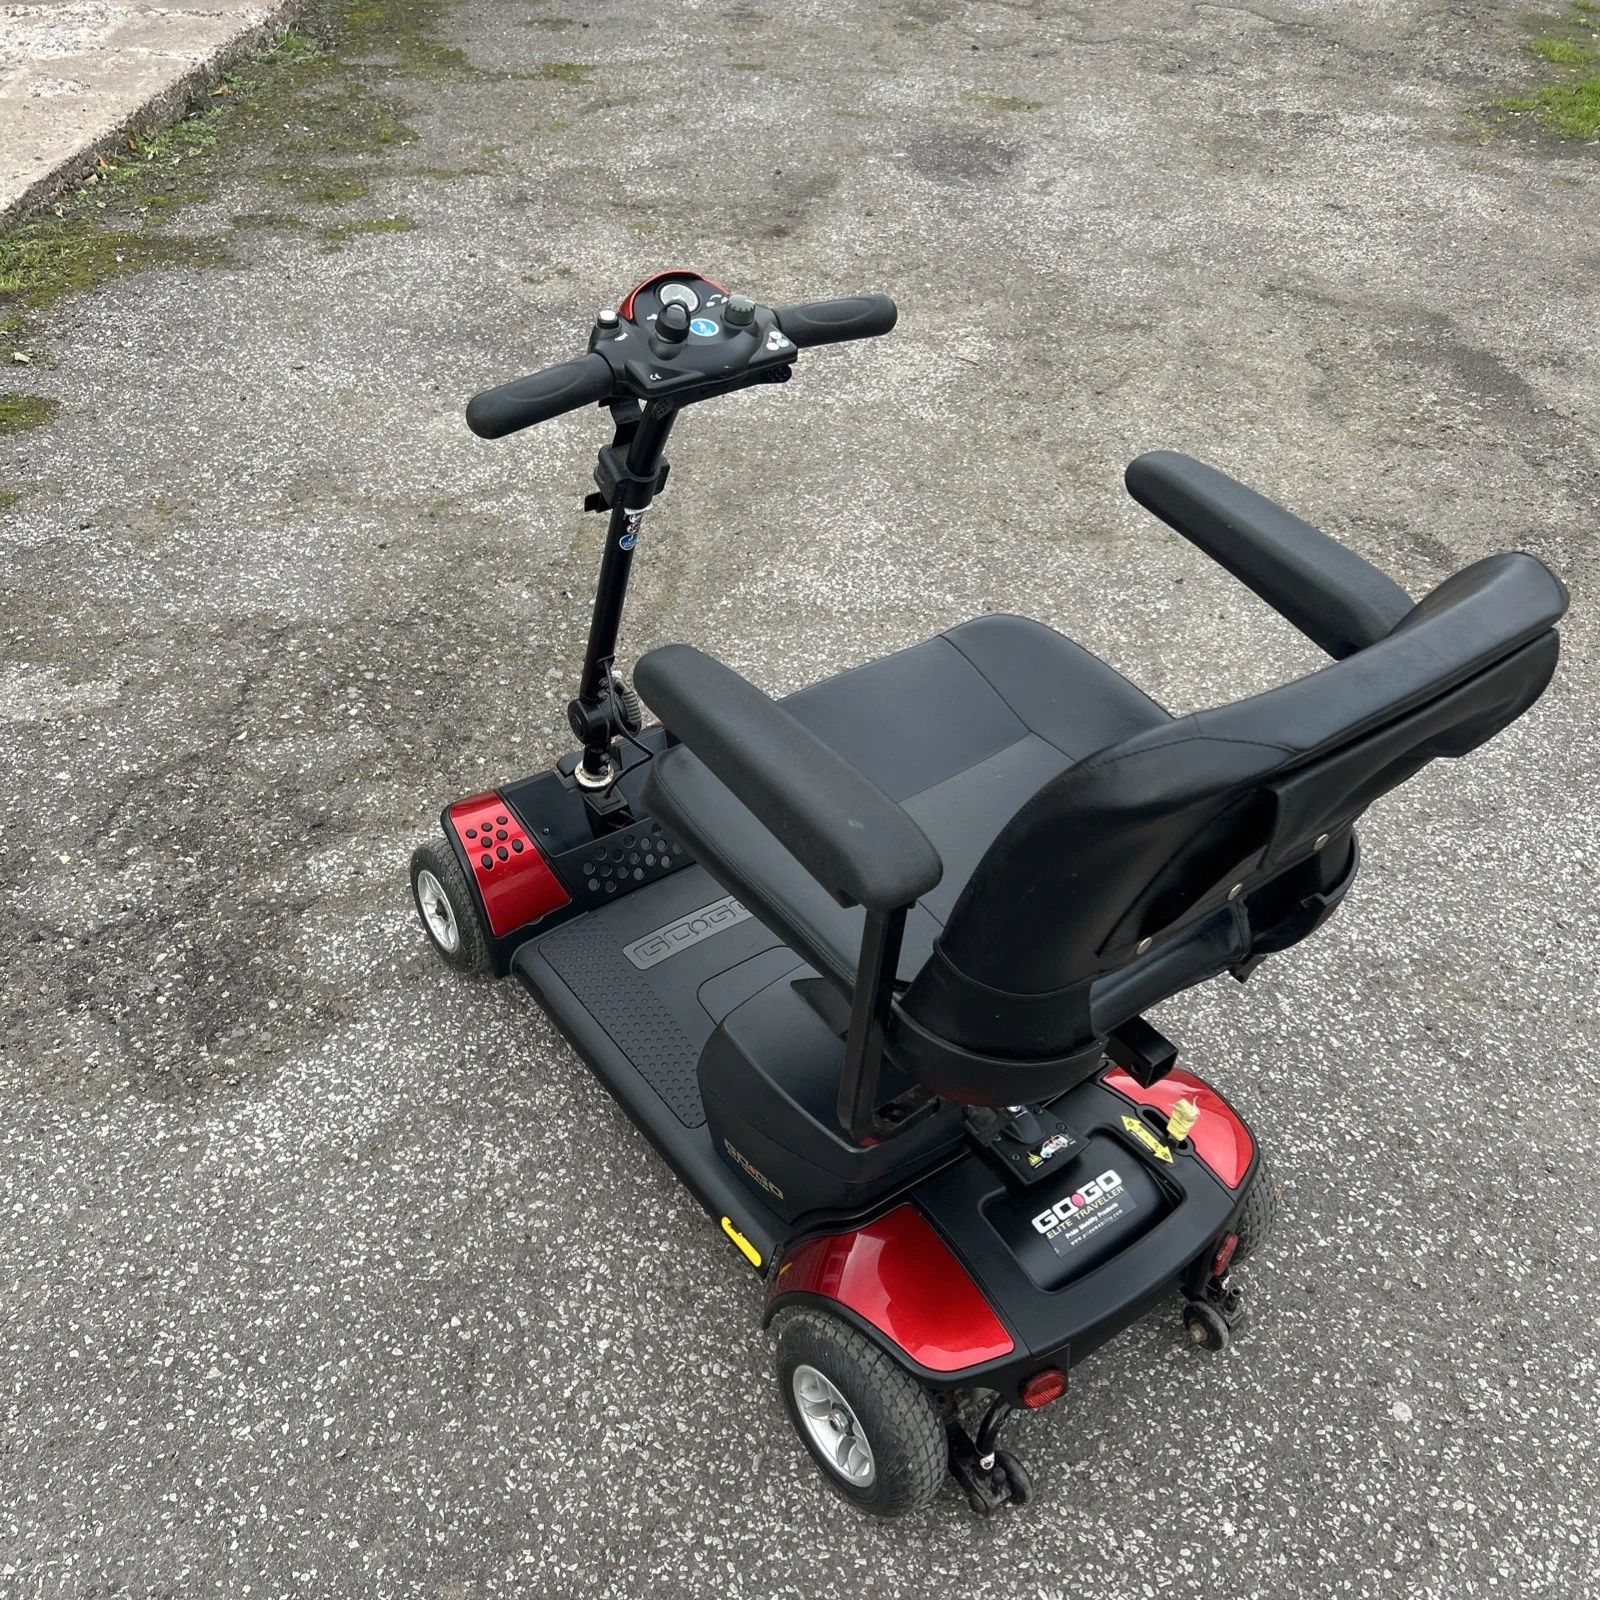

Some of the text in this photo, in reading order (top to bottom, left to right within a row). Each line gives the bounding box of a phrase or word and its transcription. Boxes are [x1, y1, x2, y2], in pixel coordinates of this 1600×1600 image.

[1045, 1186, 1125, 1240] ELITE TRAVELLER
[1064, 1202, 1119, 1240] Pride Mobility Products
